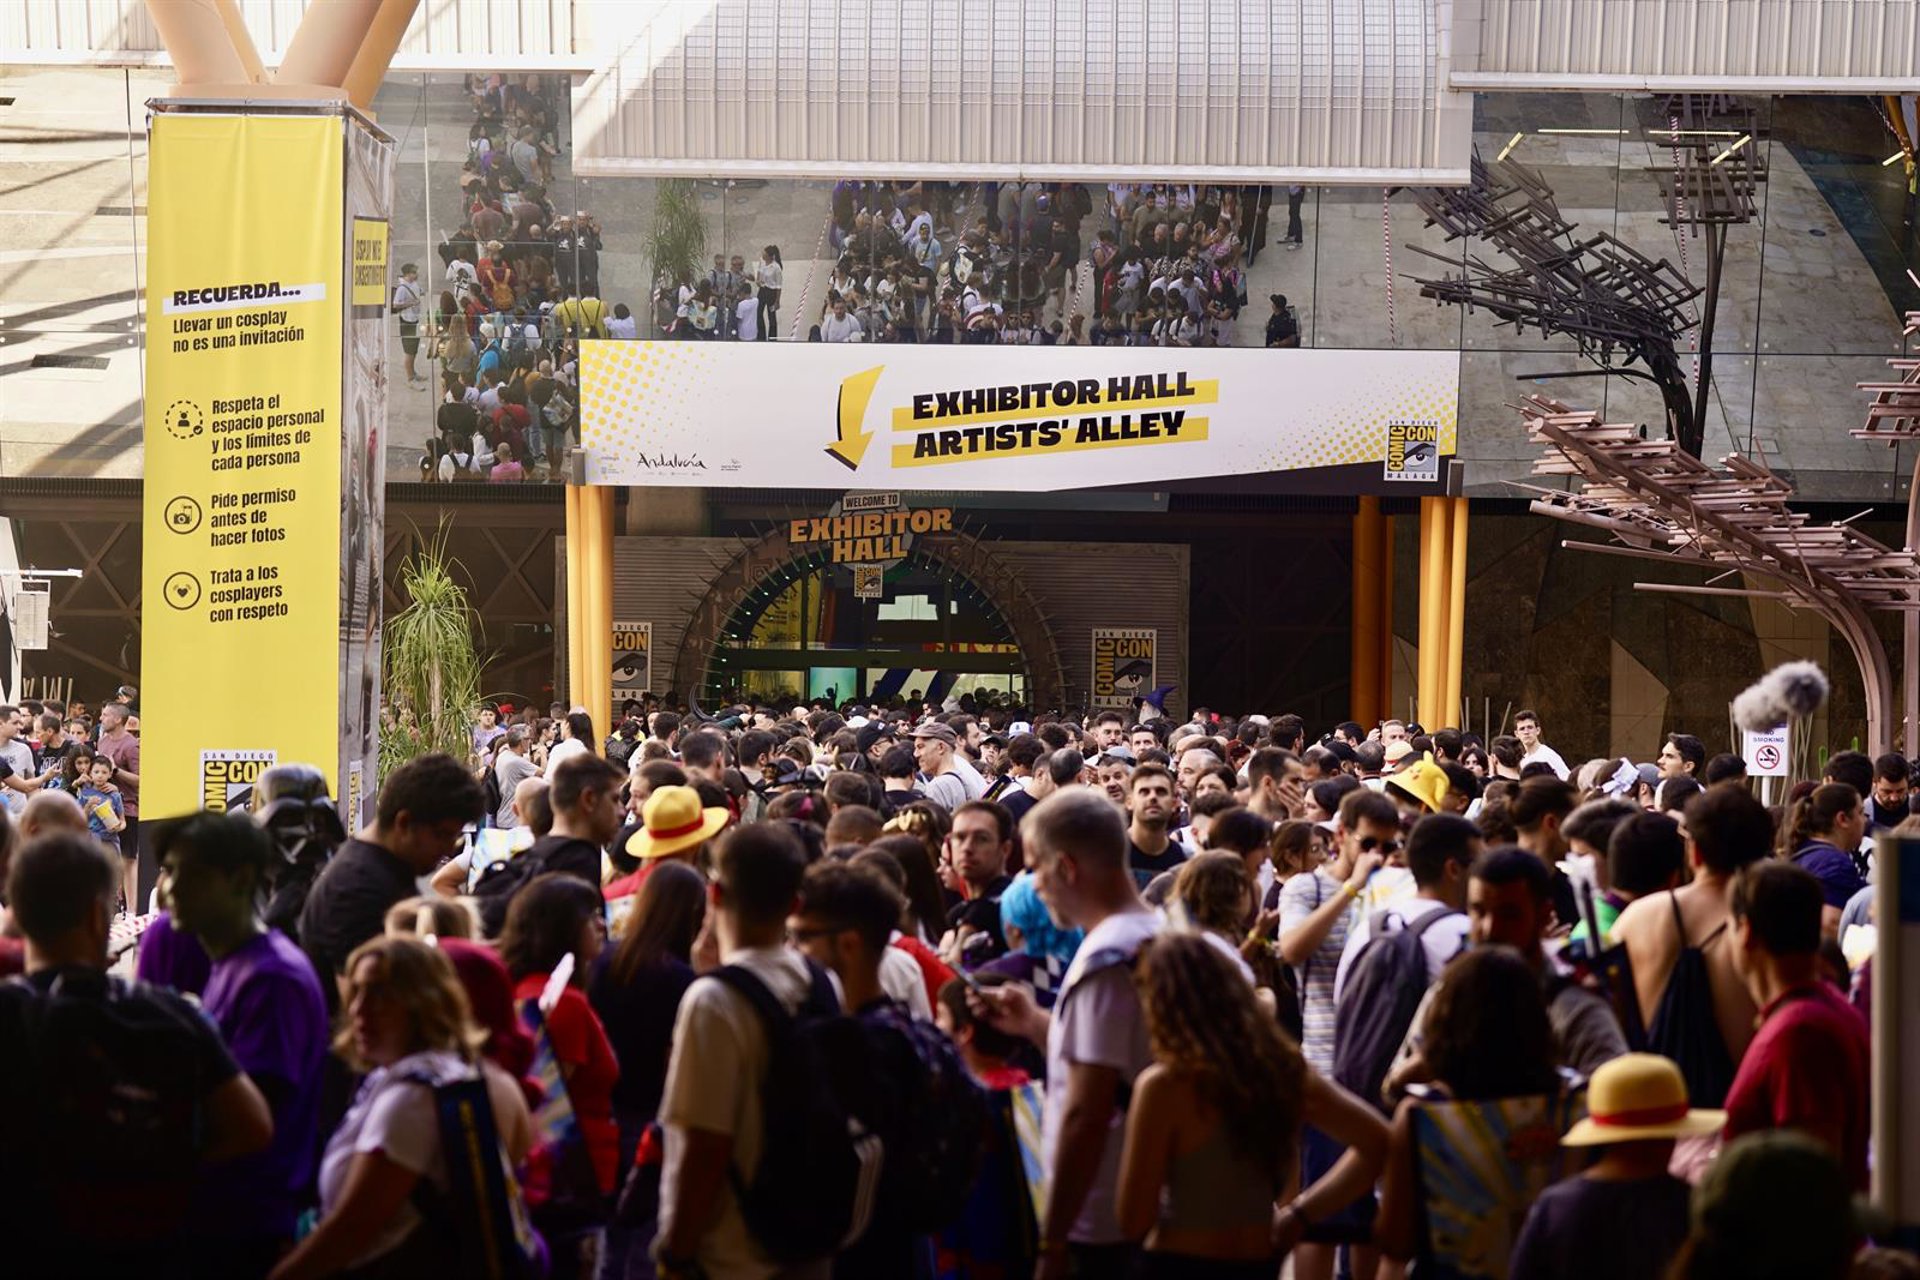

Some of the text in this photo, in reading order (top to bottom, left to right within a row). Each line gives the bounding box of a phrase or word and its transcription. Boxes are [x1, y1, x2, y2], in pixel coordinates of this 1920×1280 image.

[173, 281, 301, 306] RECUERDA...
[173, 310, 287, 334] Llevar un cosplay
[173, 326, 304, 353] no es una invitación
[212, 394, 280, 415] Respeta el
[912, 371, 1195, 420] EXHIBITOR HALL
[212, 409, 324, 434] espacio personal
[211, 430, 311, 454] y los límites de
[913, 410, 1185, 458] ARTISTS' ALLEY
[1406, 426, 1436, 441] CON
[1388, 426, 1406, 471] COMIC
[211, 450, 300, 471] cada persona
[637, 452, 708, 469] Andalucía
[211, 488, 296, 509] Pide permiso
[845, 494, 885, 508] WELCOME
[887, 493, 899, 505] TO
[211, 509, 267, 528] antes de
[790, 508, 952, 543] EXHIBITOR
[211, 527, 285, 547] hacer fotos
[832, 535, 908, 563] HALL
[210, 565, 278, 585] Trata a los
[210, 585, 283, 604] cosplayers
[210, 602, 288, 623] con respeto
[612, 631, 648, 651] CON
[1116, 639, 1152, 658] CON
[1096, 639, 1115, 695] COMIC
[203, 752, 273, 760] SAN DIEGO
[204, 761, 227, 813] OMIC
